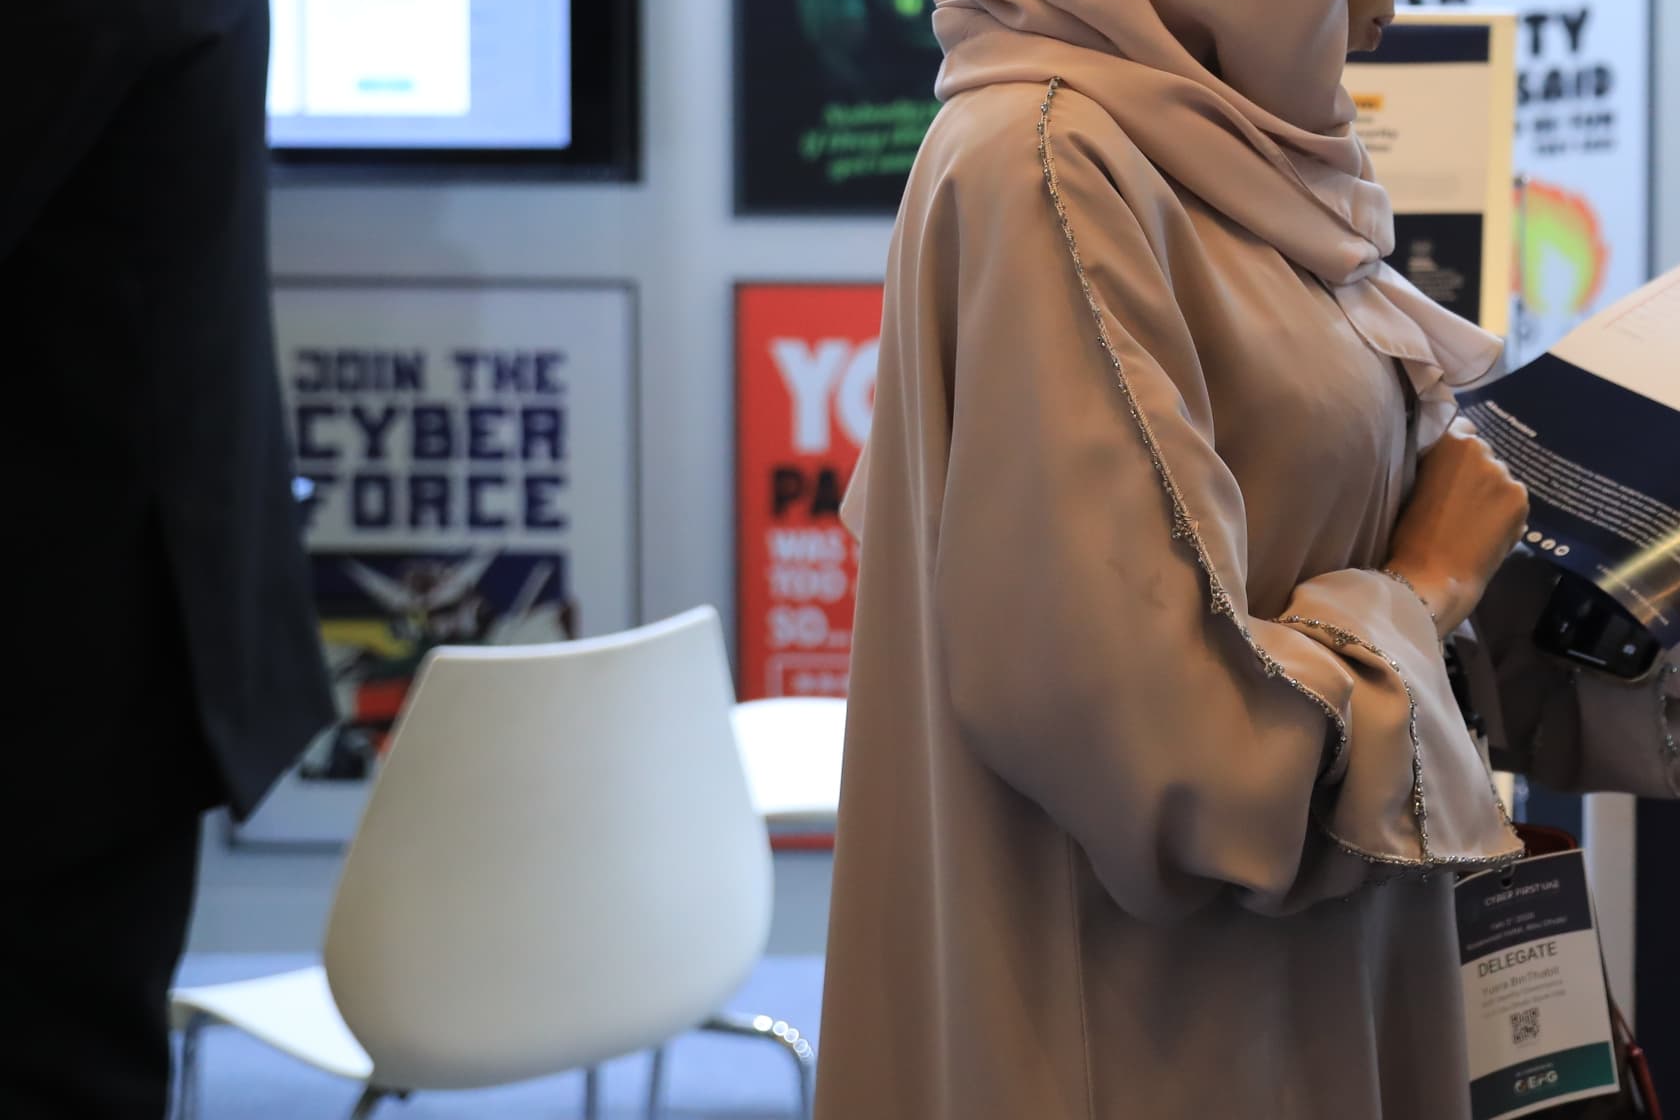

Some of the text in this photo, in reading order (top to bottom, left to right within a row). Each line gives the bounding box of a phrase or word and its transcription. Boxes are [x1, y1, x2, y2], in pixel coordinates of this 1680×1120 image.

[293, 347, 568, 395] JOIN THE
[297, 403, 567, 462] CYBER
[1477, 941, 1559, 978] DELEGATE
